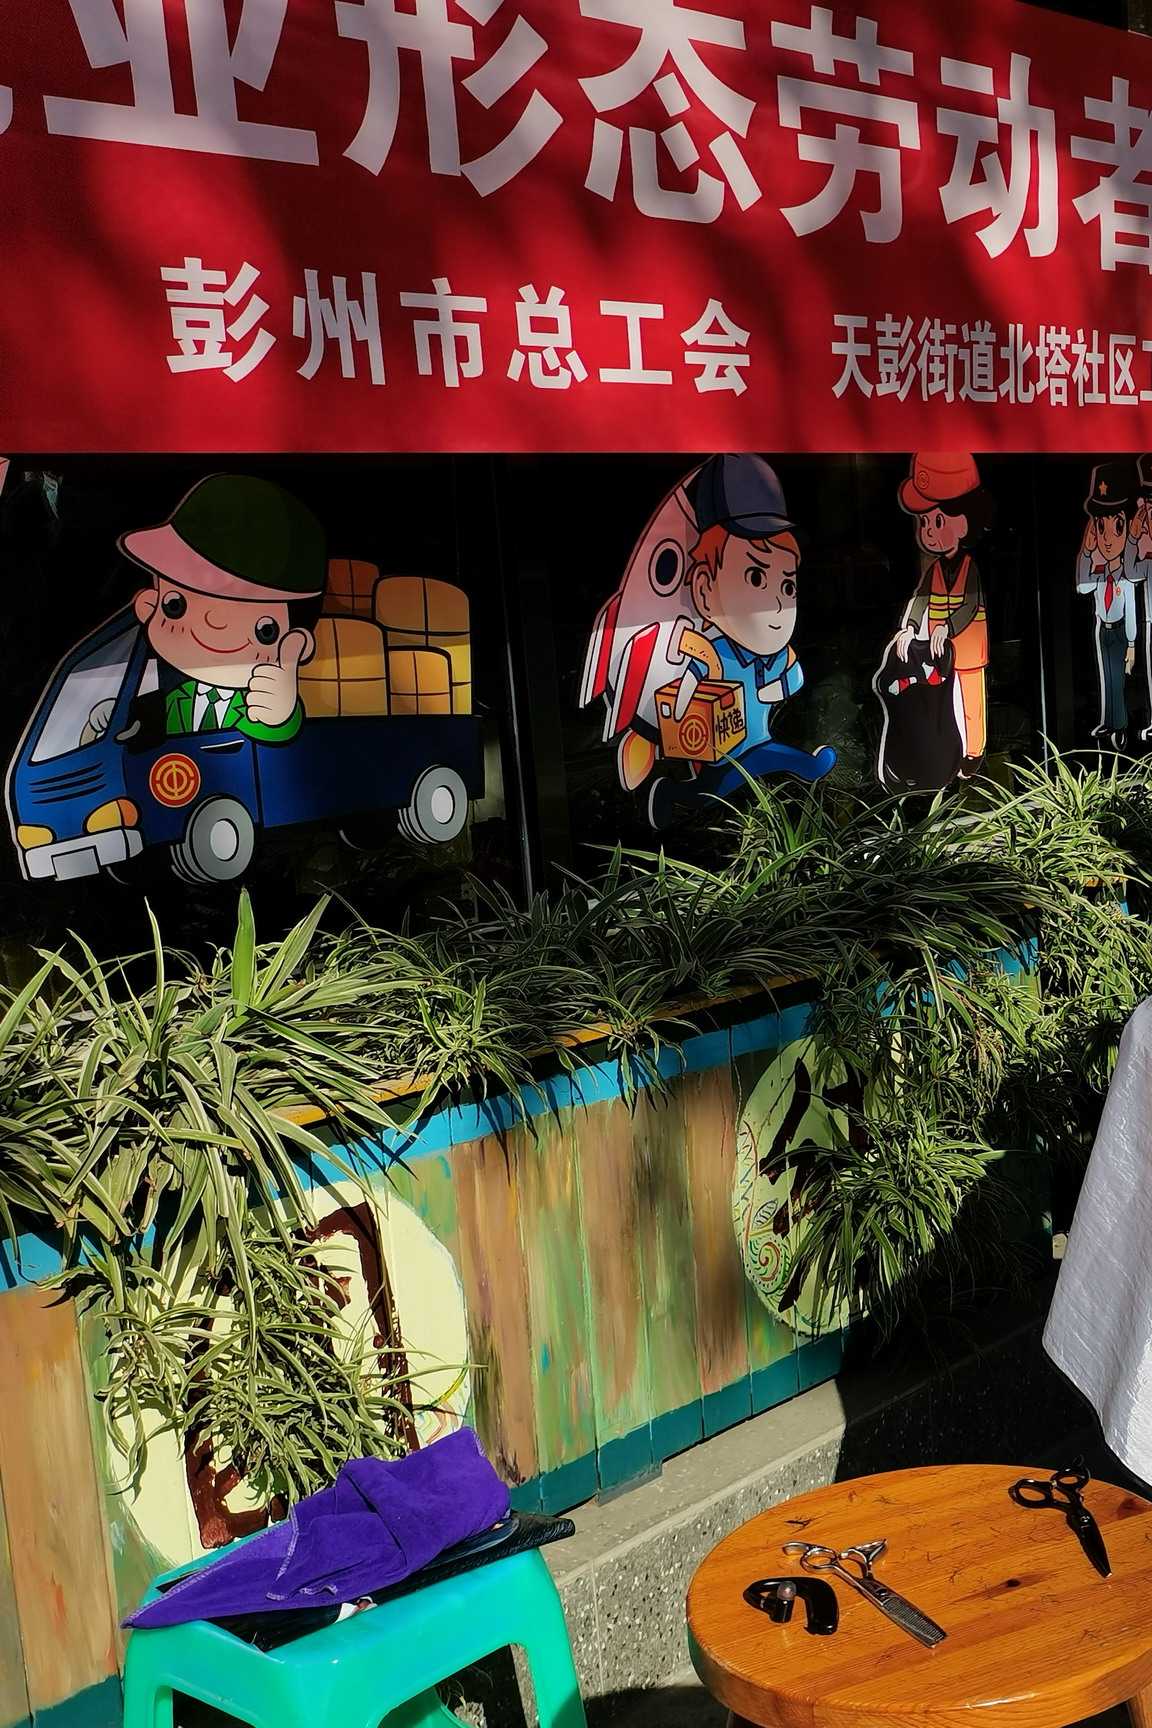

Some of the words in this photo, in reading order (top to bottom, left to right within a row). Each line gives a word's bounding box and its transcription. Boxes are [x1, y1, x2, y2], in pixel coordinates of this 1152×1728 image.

[160, 256, 751, 397] 彭州市总工会
[715, 708, 746, 745] 快递
